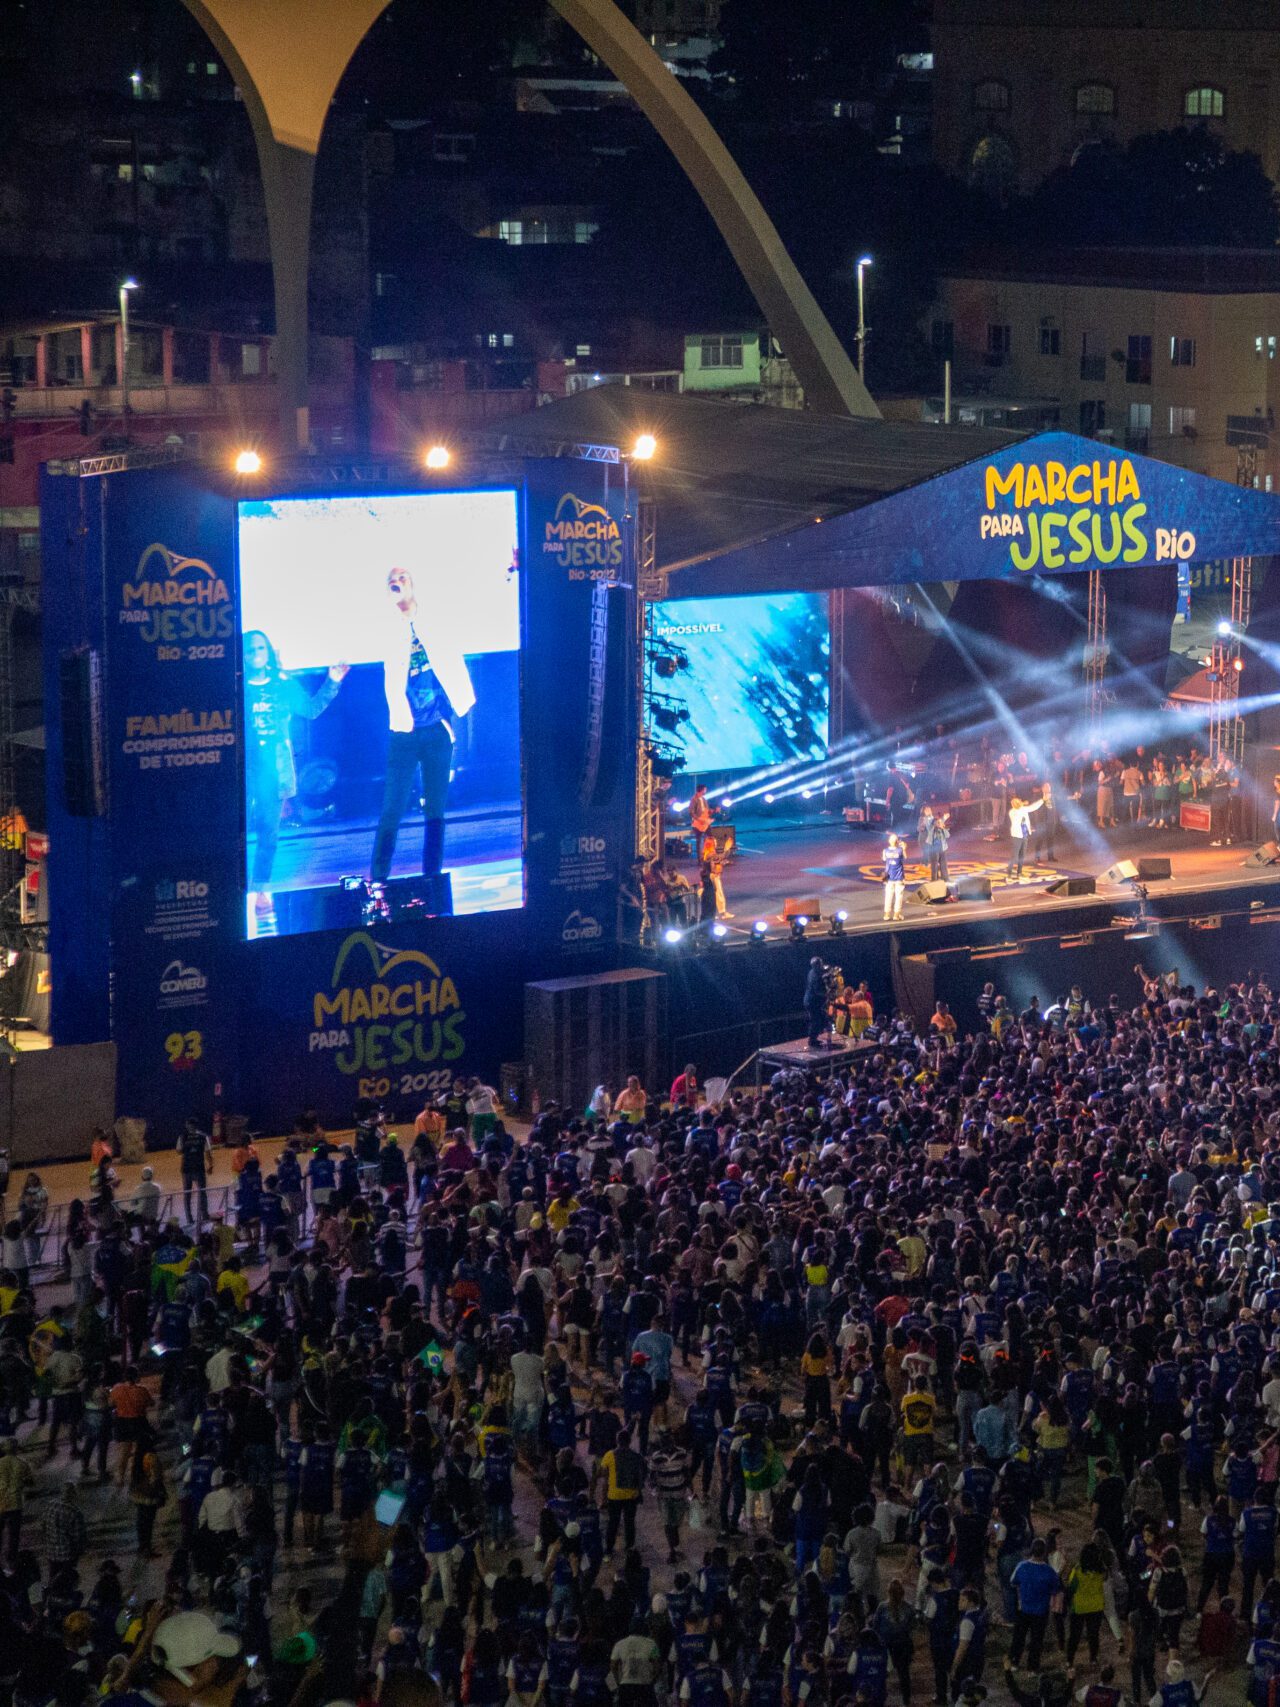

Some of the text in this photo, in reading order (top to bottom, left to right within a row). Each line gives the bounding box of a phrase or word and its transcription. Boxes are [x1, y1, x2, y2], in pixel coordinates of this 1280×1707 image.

[985, 459, 1141, 510] MARCHA
[545, 520, 620, 541] MARCHA
[981, 513, 1024, 539] PARA
[1010, 503, 1148, 571] JESUS
[542, 539, 623, 566] PARA JESUS
[123, 579, 230, 608] MARCHA
[119, 604, 234, 643] PARA JESUS
[187, 644, 224, 660] 2022
[126, 708, 232, 737] FAMÍLIA!
[122, 732, 235, 754] COMPROMISSO
[139, 750, 221, 770] DE TODOS!
[578, 836, 606, 854] Rio
[176, 880, 208, 900] Rio
[314, 976, 460, 1028] MARCHA
[165, 1030, 203, 1063] 93
[309, 1010, 467, 1074] PARA JESUS
[400, 1068, 452, 1095] 2022
